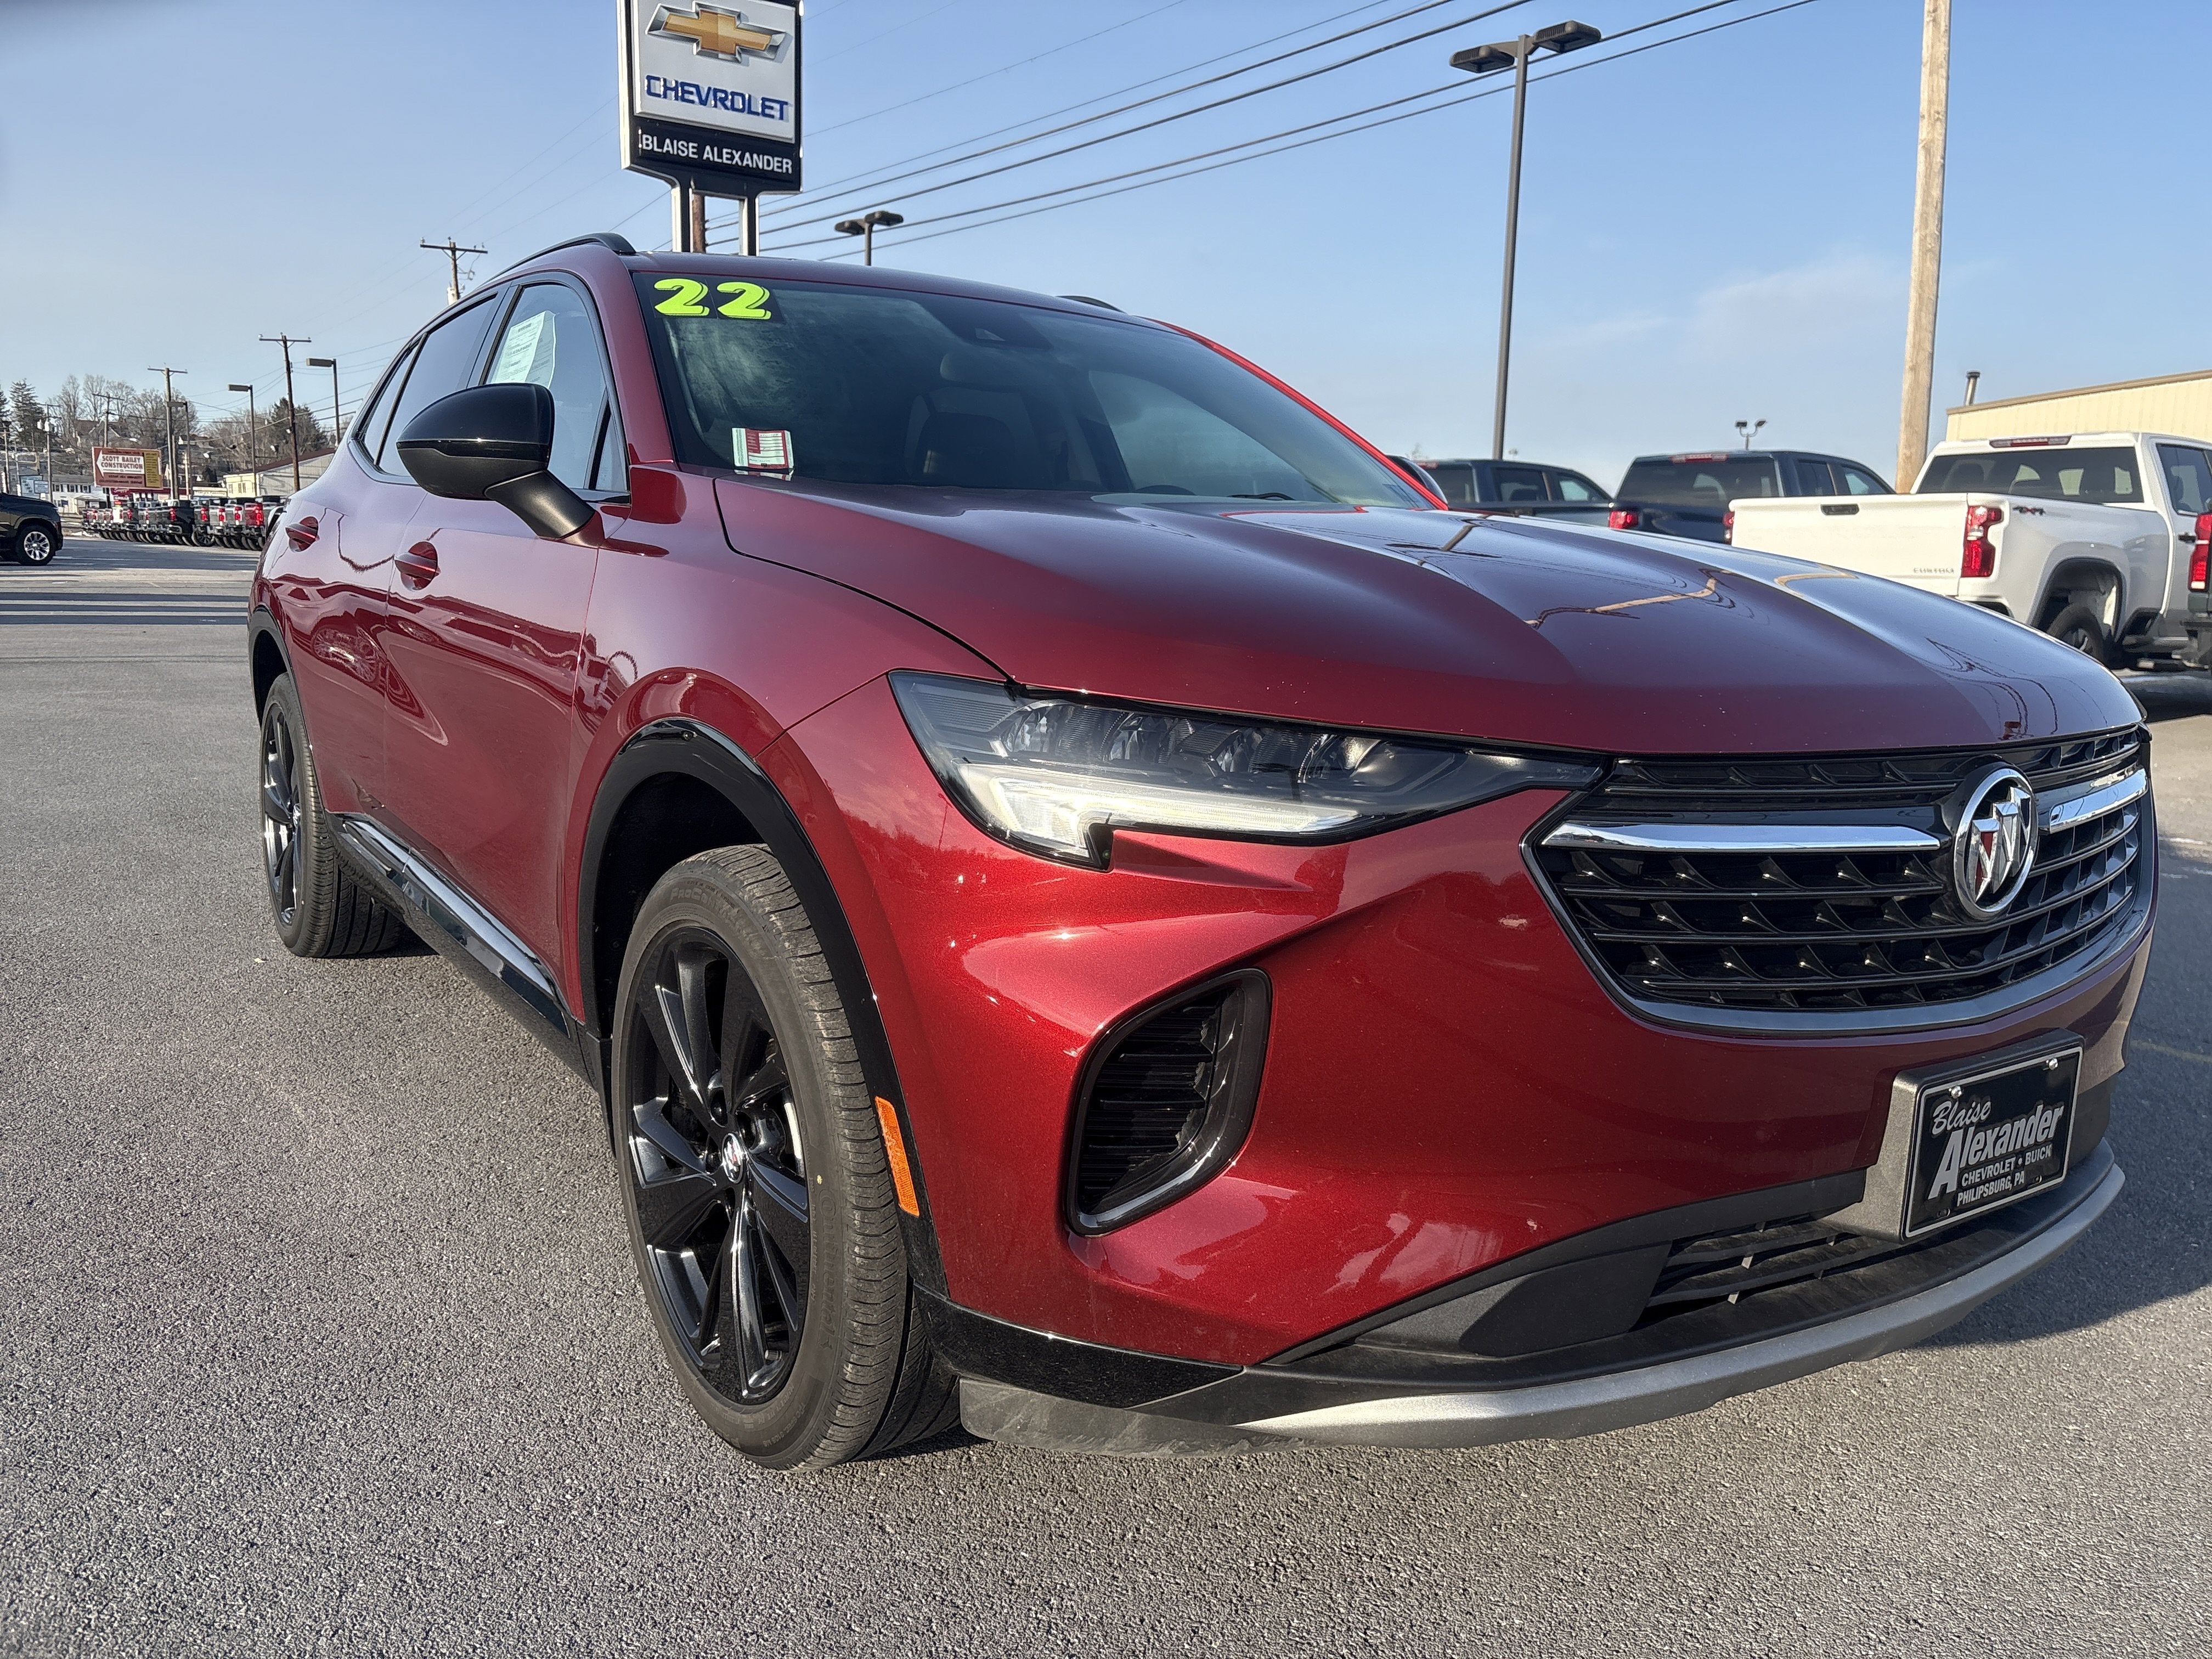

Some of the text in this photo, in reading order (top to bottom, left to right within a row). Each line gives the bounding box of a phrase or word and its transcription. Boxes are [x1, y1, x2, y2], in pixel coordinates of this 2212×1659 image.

[645, 75, 788, 120] CHEVROLET
[642, 134, 793, 174] BLAISE ALEXANDER
[654, 278, 771, 320] 22
[1932, 1101, 1991, 1135] Blaise
[1928, 1104, 2064, 1200] Alexander
[1962, 1144, 2052, 1187] CHEVROLET BUICK
[1957, 1170, 2025, 1206] PHILIPSBURG, PA
